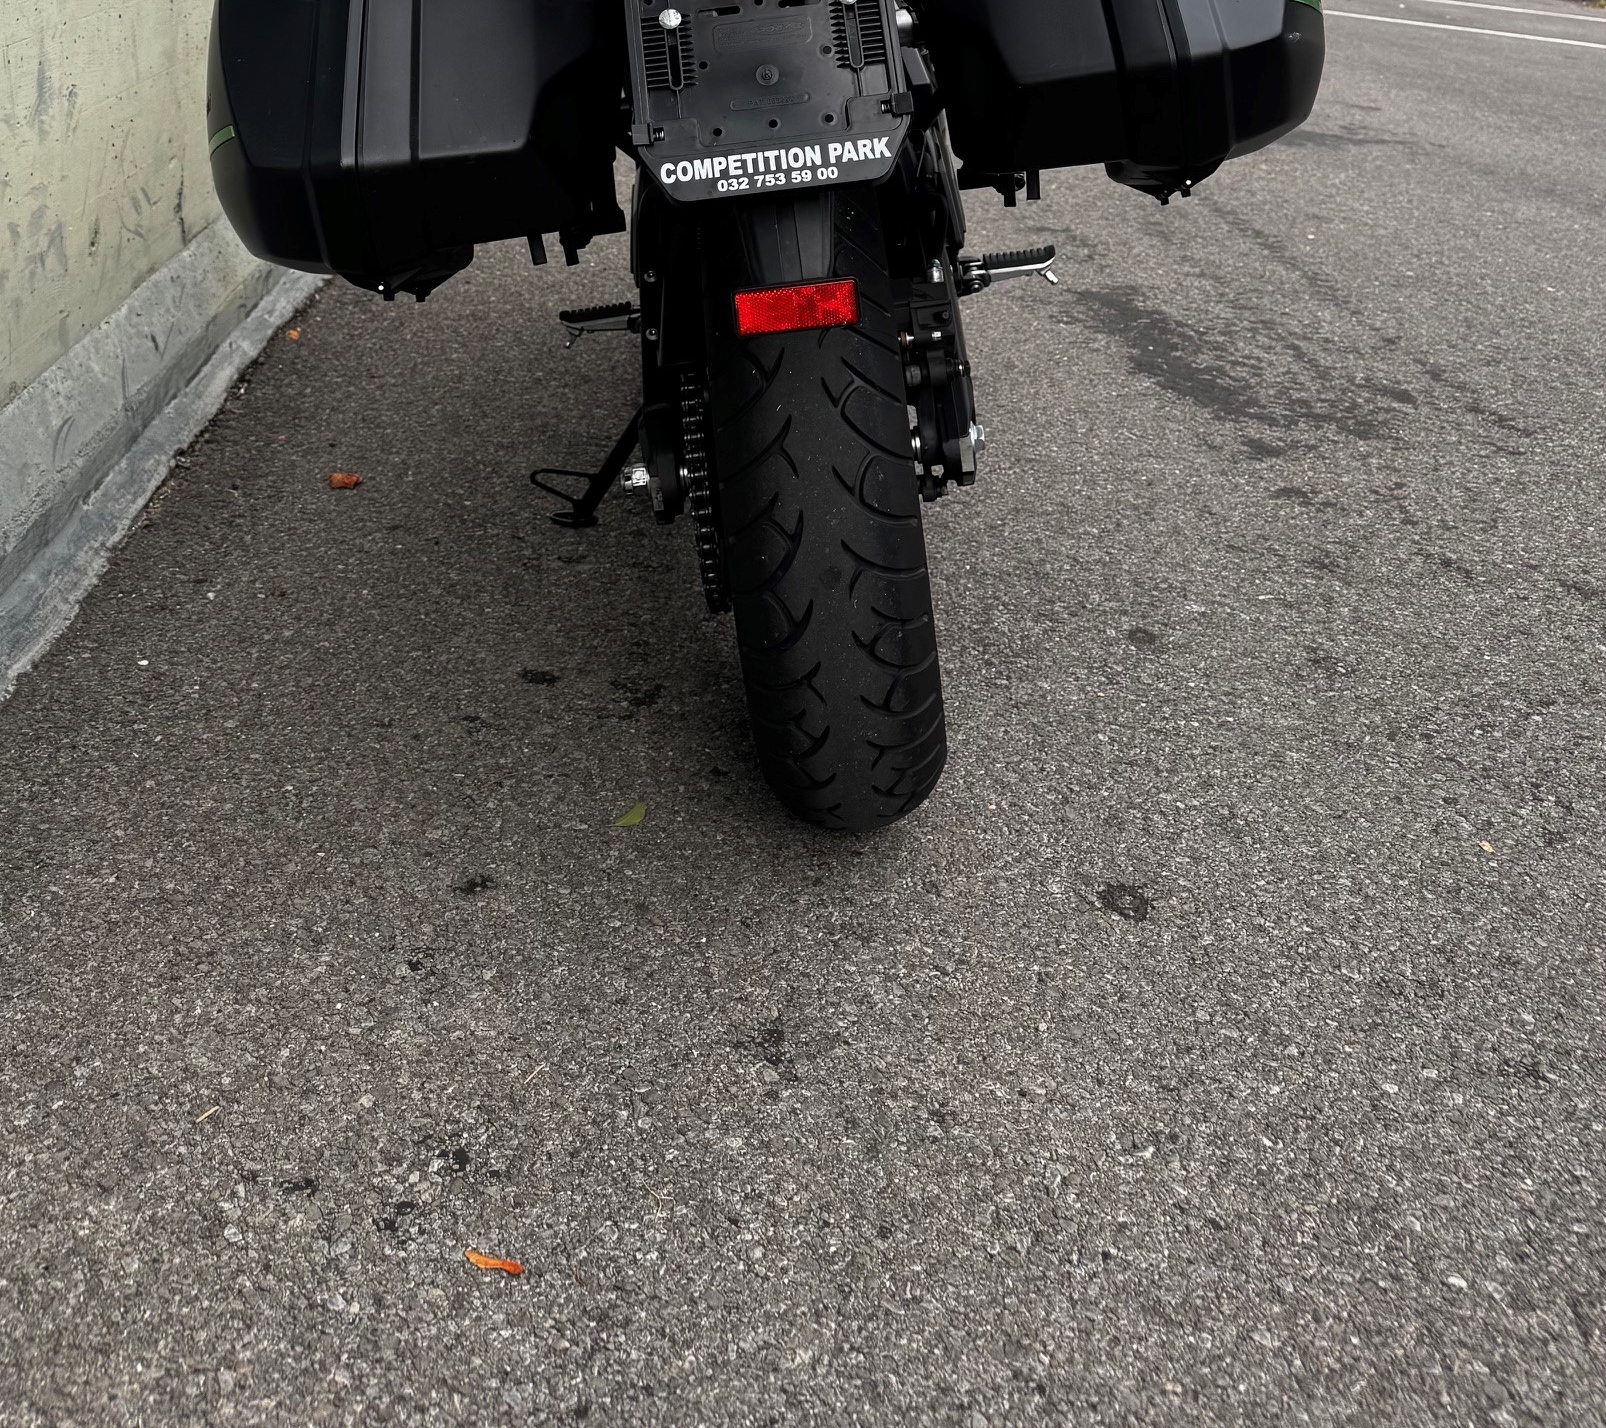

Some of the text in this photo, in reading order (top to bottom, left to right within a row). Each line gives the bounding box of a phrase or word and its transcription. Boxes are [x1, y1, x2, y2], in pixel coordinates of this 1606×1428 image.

[660, 137, 892, 184] COMPETITION PARK
[717, 166, 838, 192] 032 753 59 00
